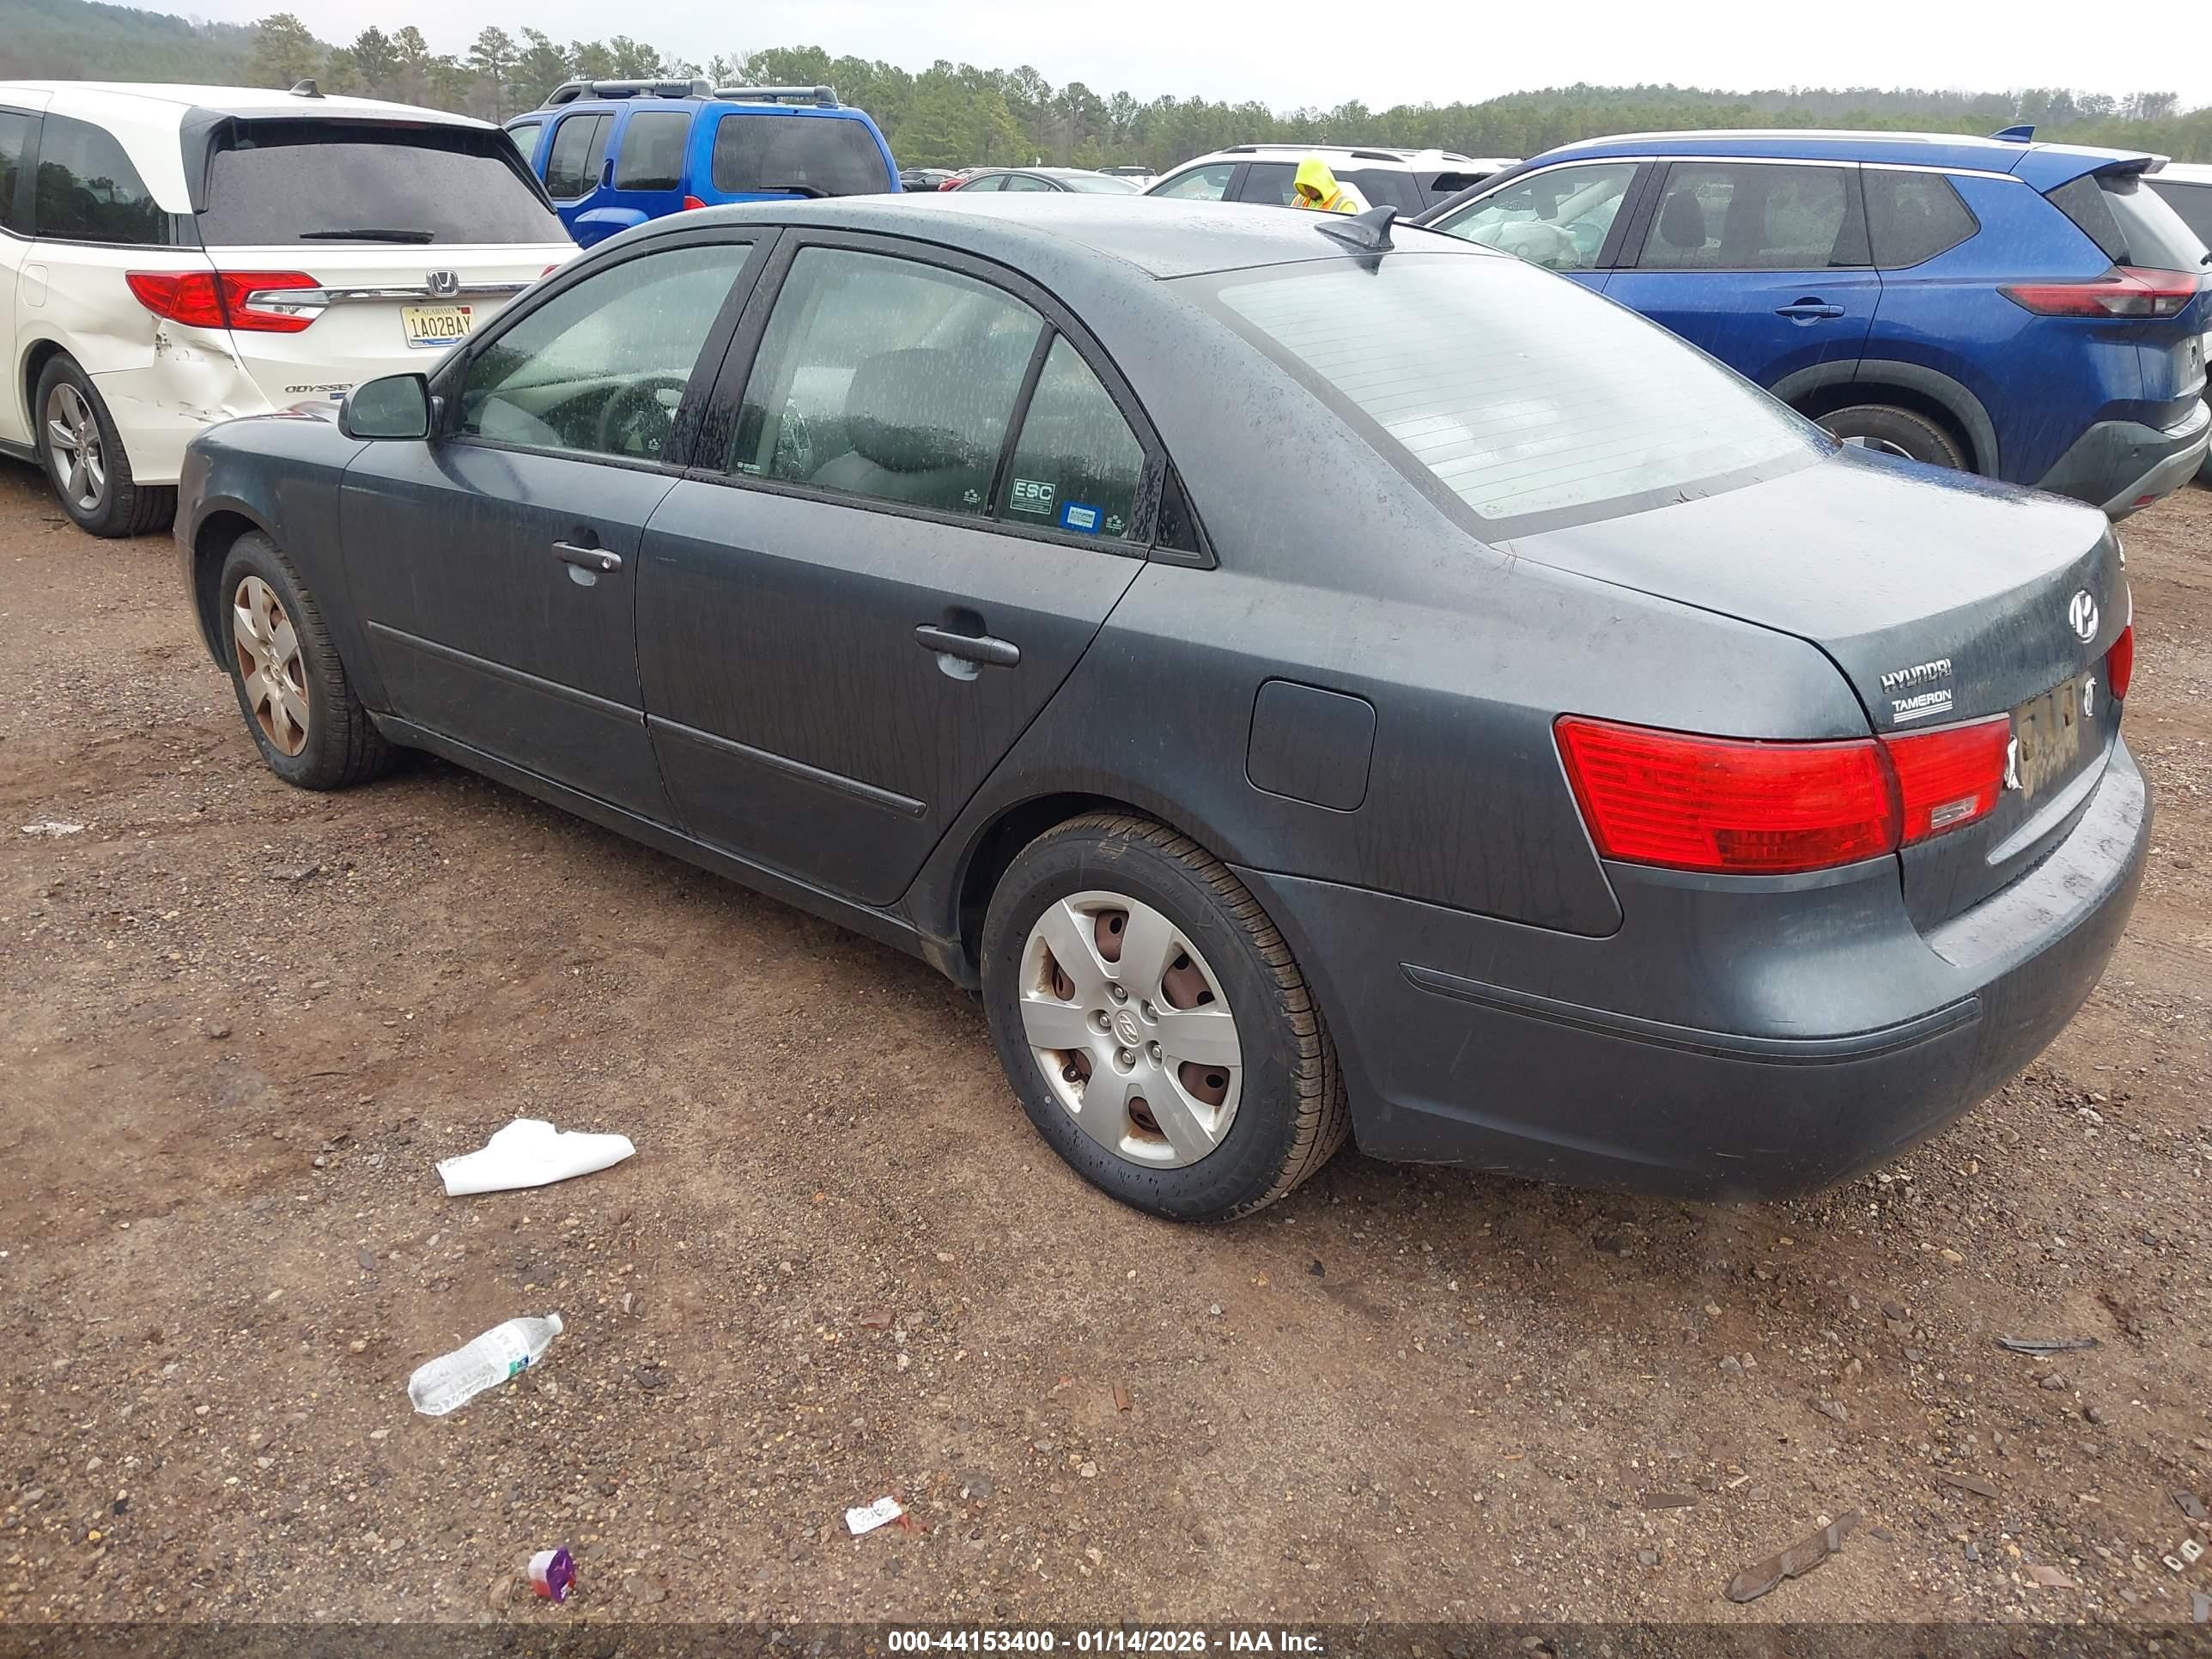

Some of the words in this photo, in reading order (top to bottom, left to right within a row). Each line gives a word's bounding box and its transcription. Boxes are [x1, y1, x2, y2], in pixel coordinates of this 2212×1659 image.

[410, 315, 471, 337] 1A02BAY
[1014, 482, 1052, 500] ESC
[1880, 659, 1952, 694] HYUNDAI
[1892, 689, 1952, 712] TAMERON
